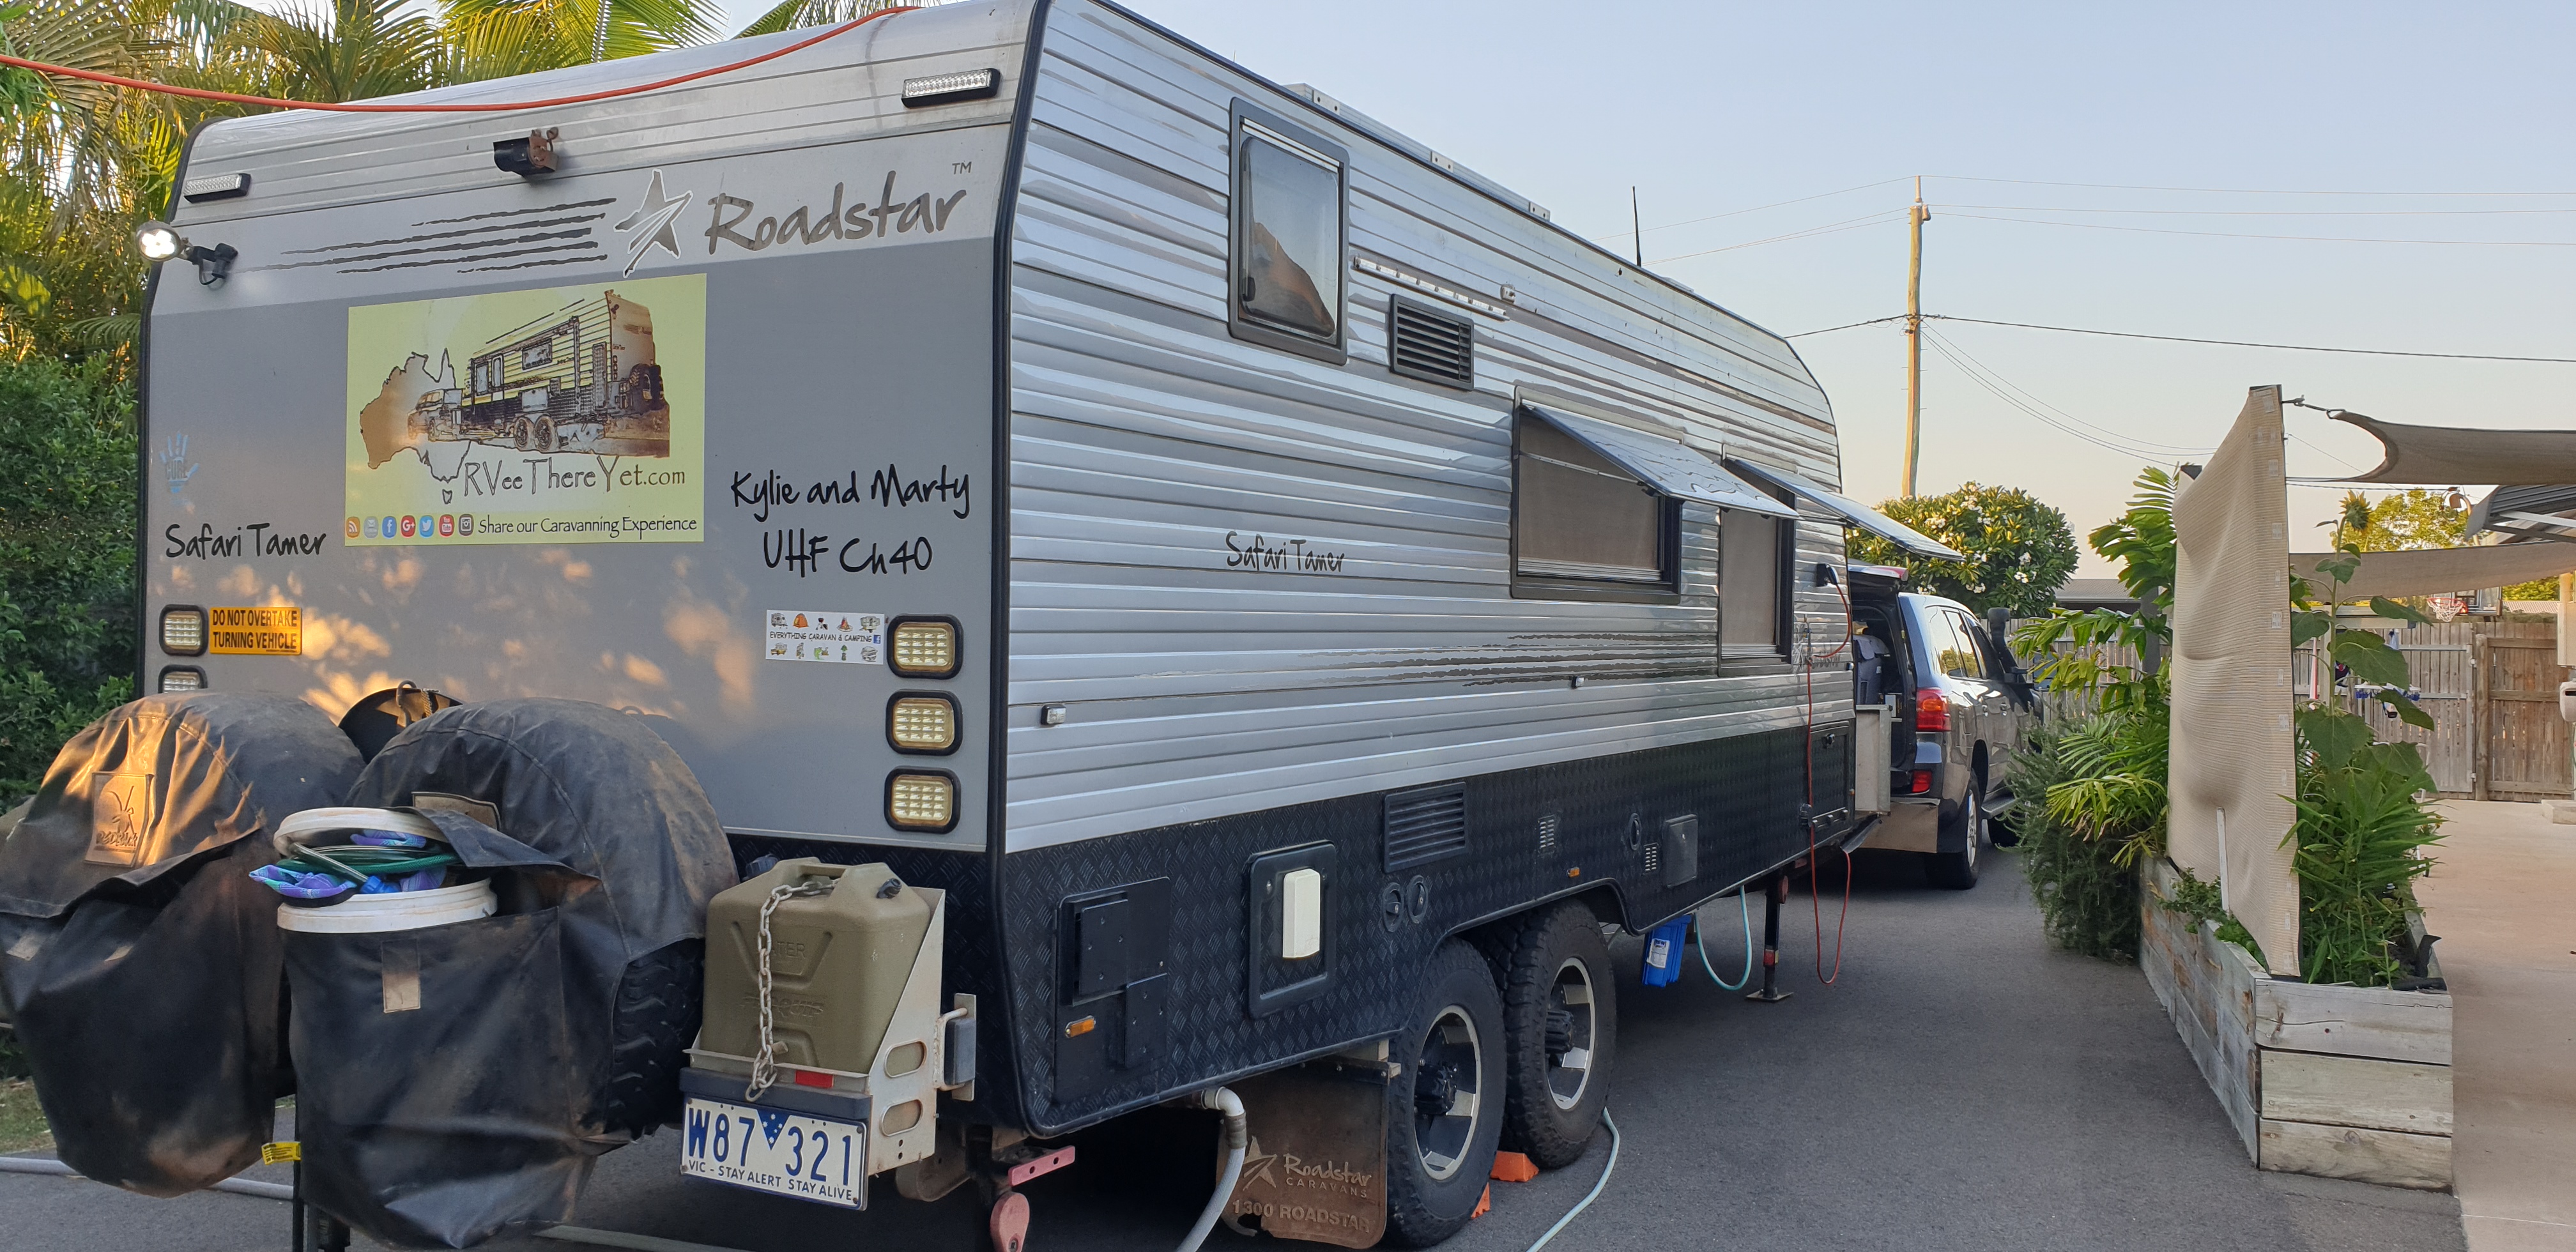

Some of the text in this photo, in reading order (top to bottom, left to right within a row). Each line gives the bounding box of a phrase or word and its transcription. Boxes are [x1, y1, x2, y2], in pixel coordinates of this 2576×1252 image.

[705, 171, 967, 255] Roadstar
[731, 464, 970, 522] Kylie and Marty
[165, 523, 326, 560] Safari Tamer
[479, 514, 697, 540] Share our Caravanning Experience
[763, 528, 829, 577] UHF
[1225, 531, 1344, 572] Safari Tamer
[213, 609, 297, 627] DO NOT OVERTAKE
[770, 631, 806, 640] EVERYTHING
[213, 632, 297, 649] TURNING VEHICLE
[688, 1108, 852, 1186] W87 321
[689, 1159, 706, 1173] VIC
[718, 1165, 746, 1180] STAY
[747, 1172, 781, 1187] ALERT
[788, 1179, 816, 1194] STAY
[819, 1186, 852, 1201] ALIVE
[1284, 1153, 1372, 1187] Roadstar
[1285, 1177, 1367, 1198] CARAVANS
[1232, 1200, 1370, 1233] 1300 ROADSTAR
